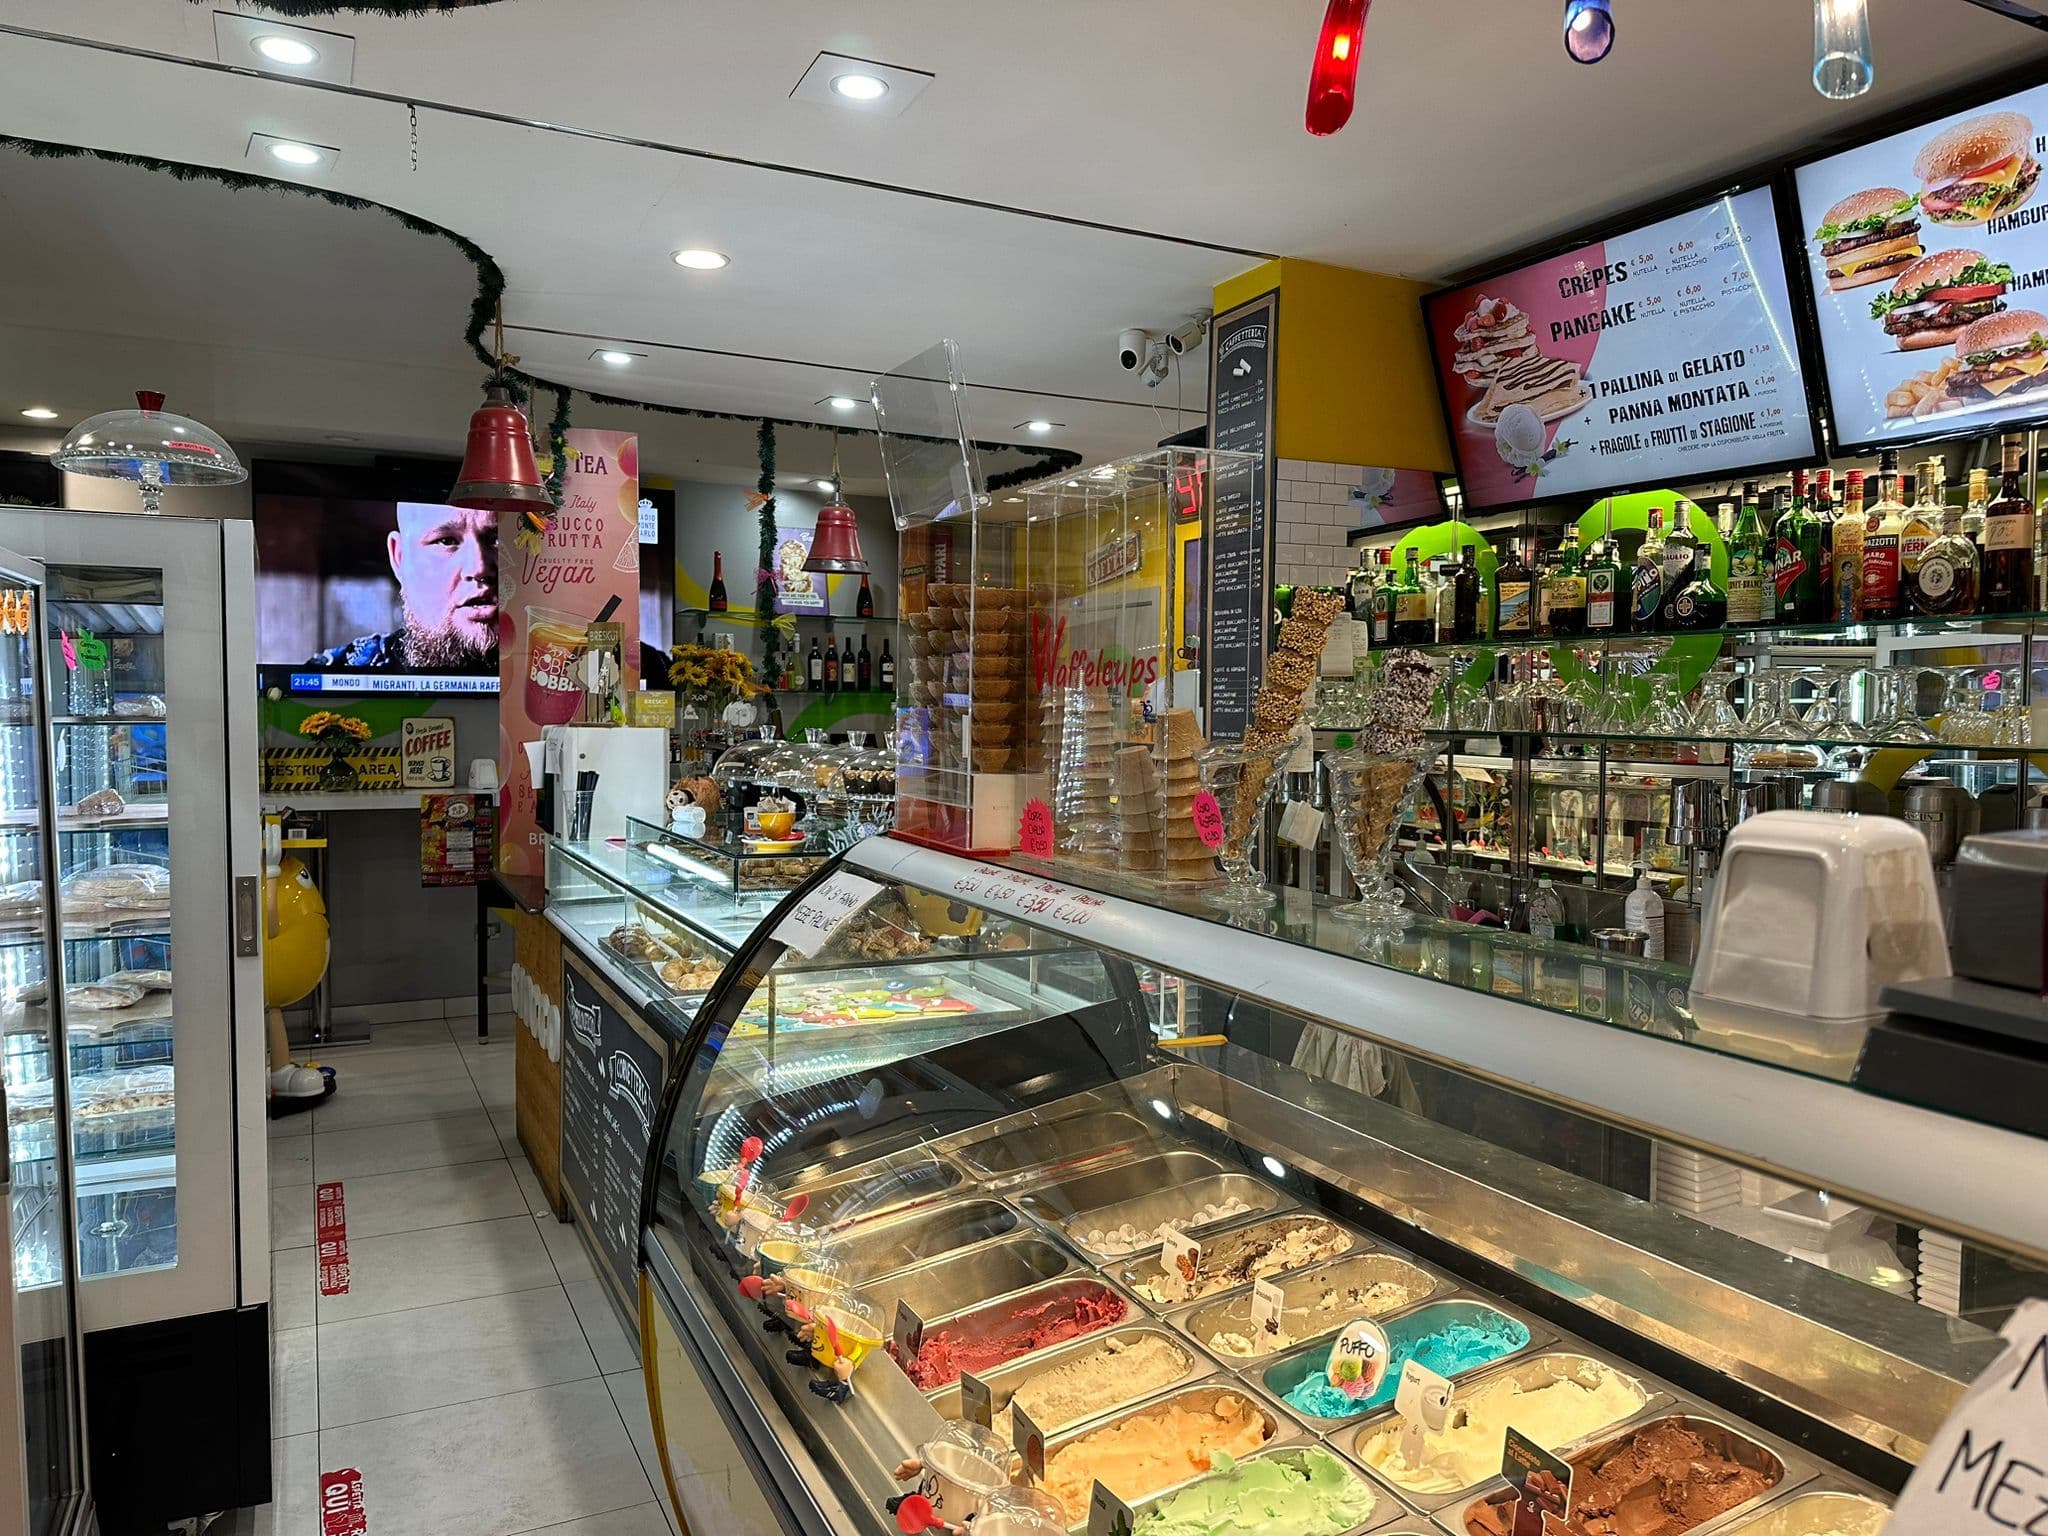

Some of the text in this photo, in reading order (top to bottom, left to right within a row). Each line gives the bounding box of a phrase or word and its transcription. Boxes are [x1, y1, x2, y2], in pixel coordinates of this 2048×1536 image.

[1672, 253, 1699, 264] NUTELLA
[1559, 261, 1628, 299] CRÊPES
[1632, 265, 1658, 277] NUTELLA
[1640, 307, 1666, 319] NUTELLA
[1680, 296, 1706, 308] NUTELLA
[1550, 302, 1637, 342] PANCAKE
[1600, 369, 1664, 397] PALLINA
[1668, 371, 1679, 383] DI
[1682, 350, 1746, 379] GELATO
[1609, 399, 1664, 424] PANNA
[1669, 381, 1750, 413] MONTATA
[1599, 433, 1642, 456] FRAGOLE
[1651, 425, 1688, 447] FRUTTI
[1690, 429, 1698, 440] DI
[1700, 412, 1756, 438] STAGIONE
[574, 452, 609, 475] TEA
[569, 494, 598, 513] Italy
[522, 551, 596, 594] Vegan
[1031, 608, 1158, 696] Waffelcups
[294, 678, 320, 687] 21:45
[332, 678, 360, 687] MONDO
[420, 681, 431, 690] LA
[433, 681, 478, 691] GERMANIA
[405, 730, 451, 758] COFFEE
[358, 763, 398, 775] AREA
[321, 1241, 337, 1257] QUI
[1340, 1337, 1375, 1358] PUFFO
[325, 1483, 349, 1514] QUI
